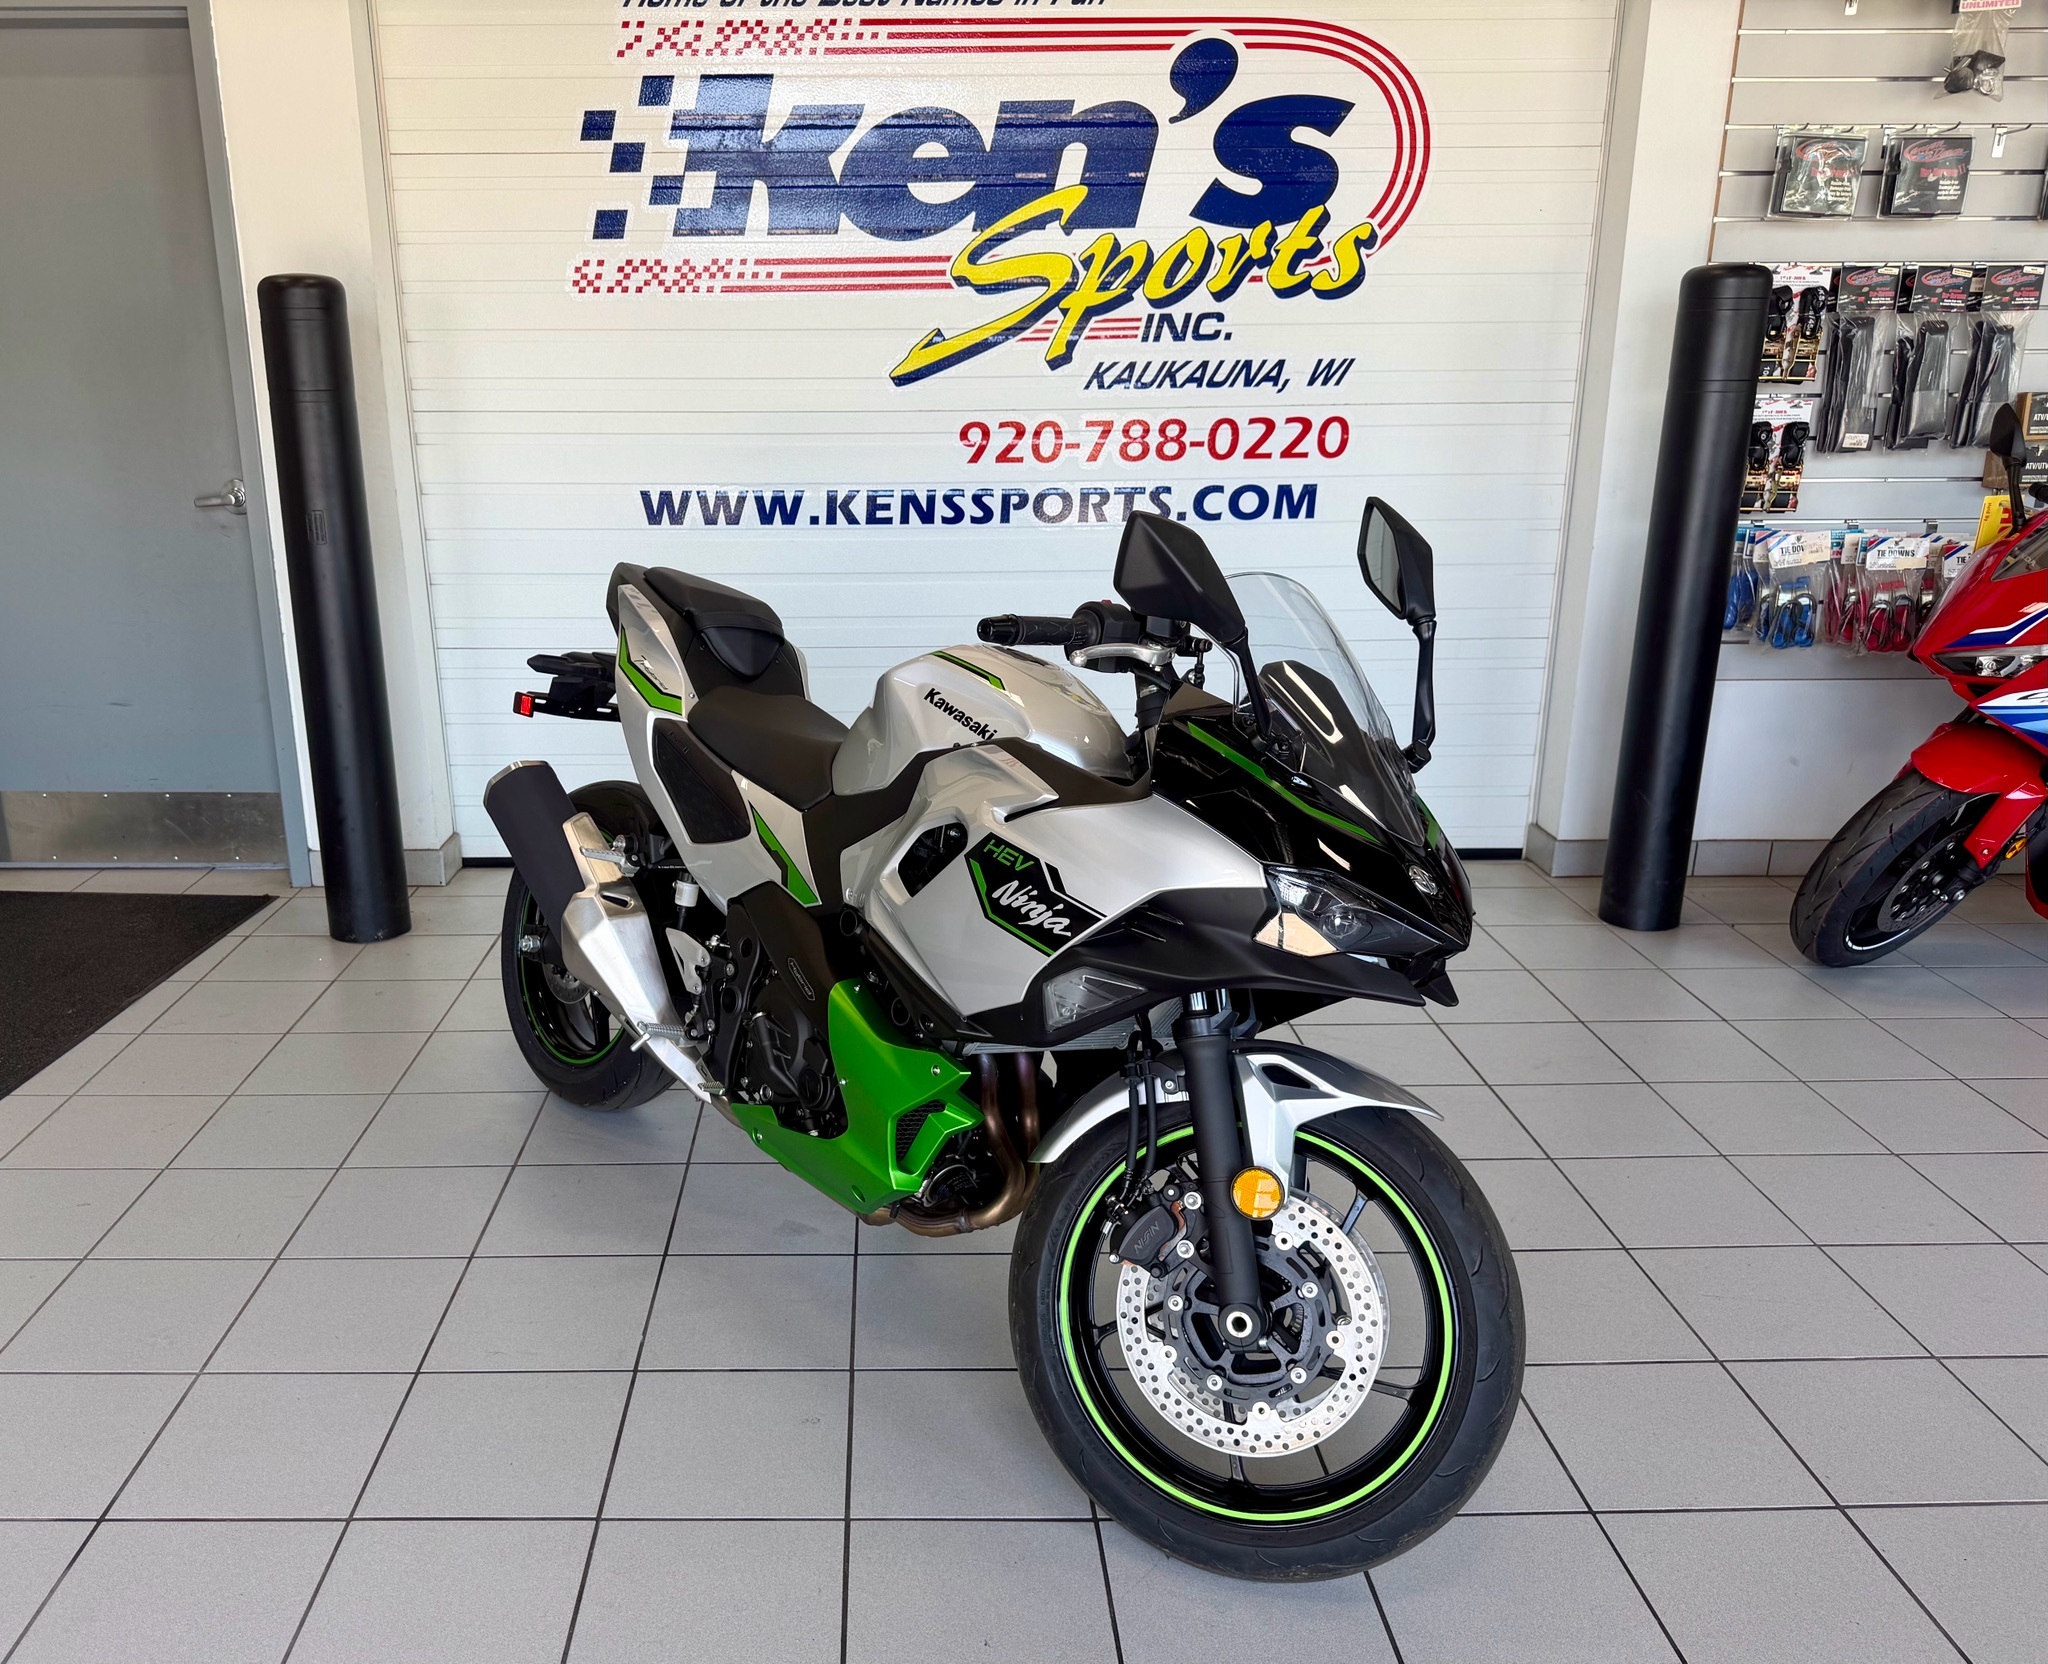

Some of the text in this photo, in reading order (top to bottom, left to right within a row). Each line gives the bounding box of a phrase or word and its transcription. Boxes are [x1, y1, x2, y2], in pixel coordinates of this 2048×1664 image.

[672, 38, 1356, 241] ken's
[889, 185, 1378, 387] Sports
[1140, 312, 1233, 343] INC.
[1082, 358, 1355, 393] KAUKAUNA, WI
[959, 415, 1350, 464] 920-788-0220
[639, 483, 1318, 526] WWW.KENSSPORTS.COM
[1876, 549, 1916, 557] TIE DOWNS
[1956, 556, 1967, 564] TIE
[924, 687, 998, 740] Kawasaki
[983, 839, 1035, 871] HEV
[991, 879, 1072, 937] Ninja
